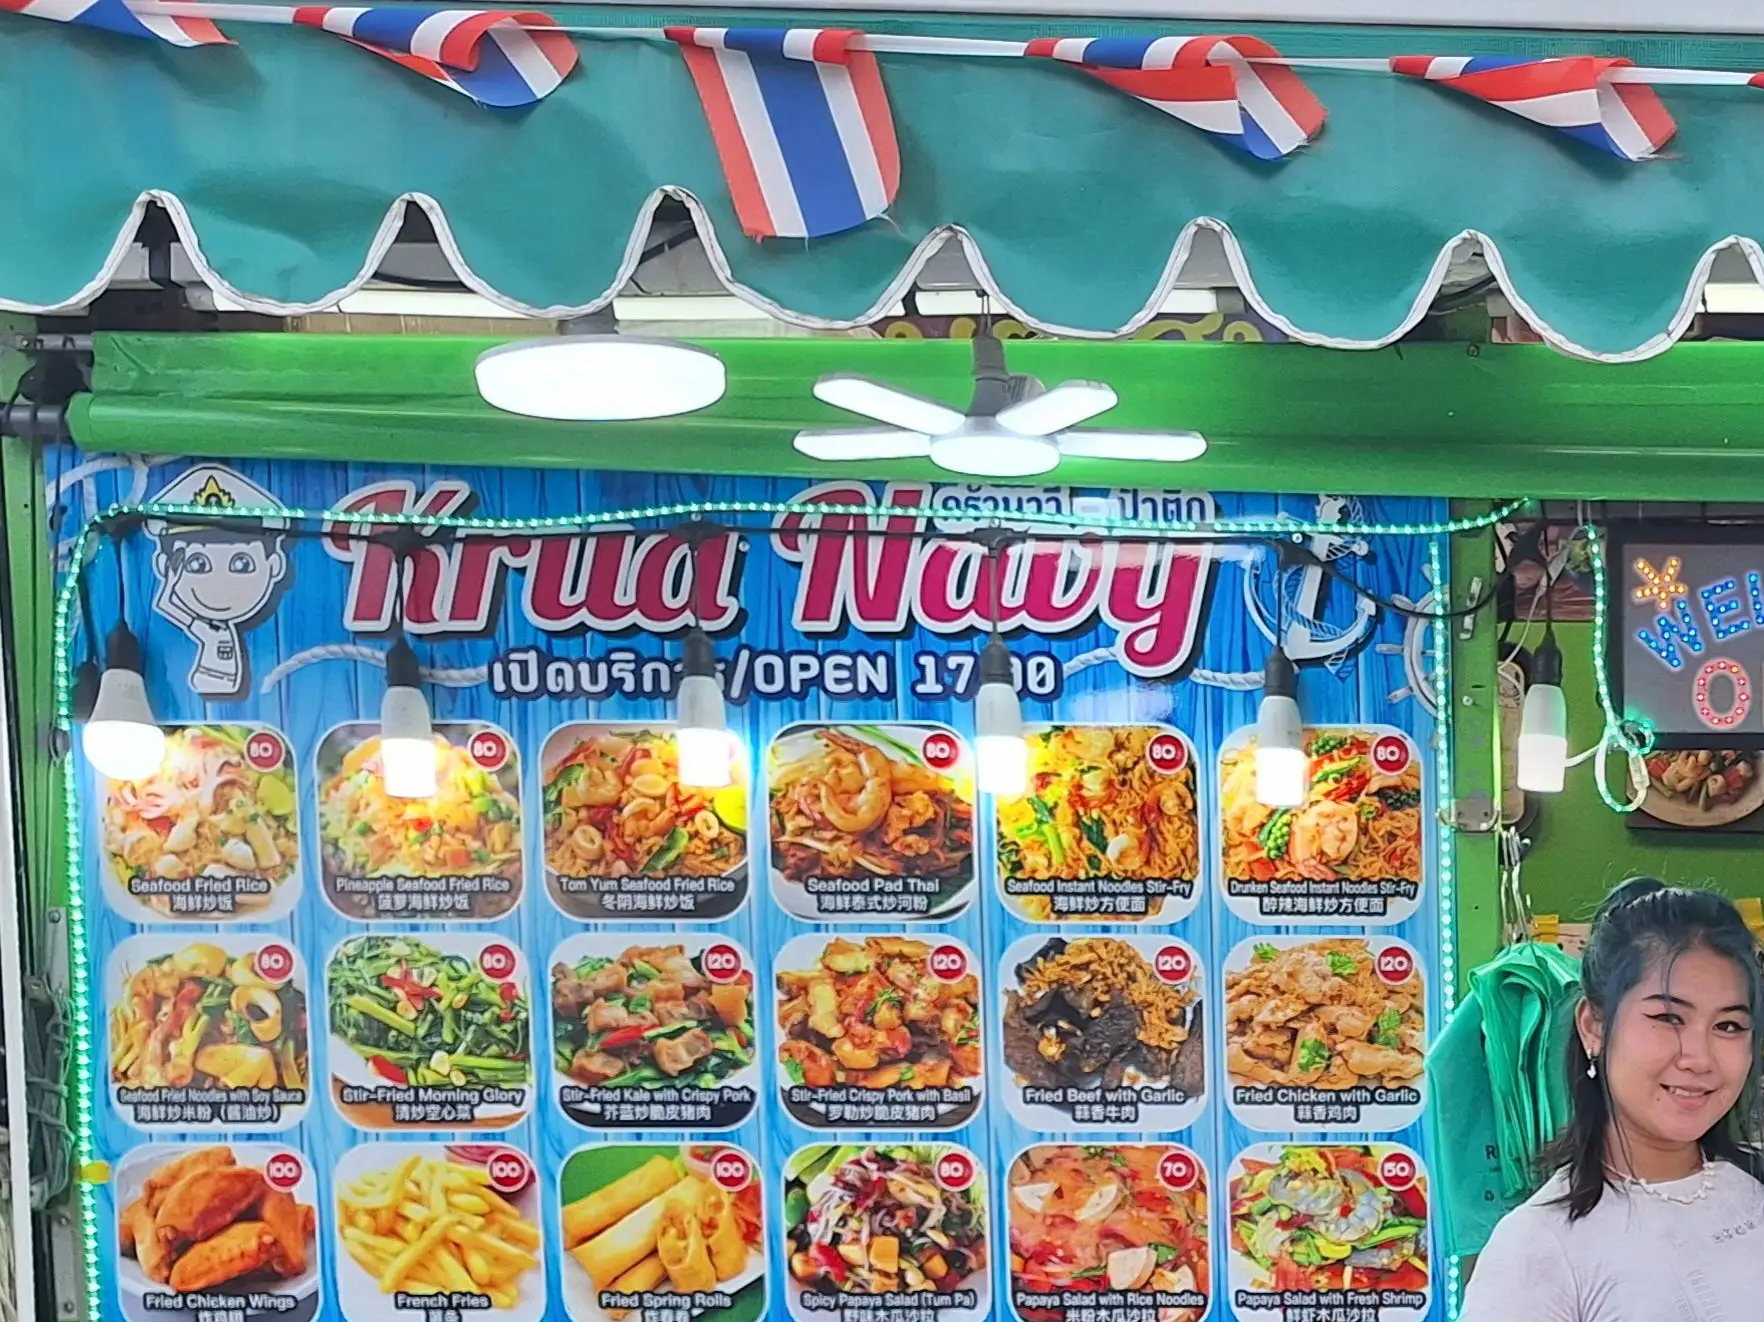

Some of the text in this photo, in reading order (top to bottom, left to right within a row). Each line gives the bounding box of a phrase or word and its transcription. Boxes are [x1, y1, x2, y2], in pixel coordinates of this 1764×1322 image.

[323, 482, 1218, 679] Krua Navy
[915, 654, 1057, 694] 170
[132, 879, 267, 892] Seafood Fried Rice
[560, 879, 735, 891] Tom Yum Seafood Fried Rice
[808, 879, 939, 892] Seafood Pad Thai
[172, 894, 232, 910] 海鲜炒饭
[1025, 1089, 1184, 1103] Fried Beef with Garlic
[1237, 1089, 1417, 1103] Fried Chicken with Garlic
[1073, 1105, 1135, 1120] 蒜香牛肉
[1296, 1105, 1357, 1120] 蒜香鸡肉
[146, 1295, 294, 1311] Fried Chicken Wings
[397, 1294, 488, 1308] French Fries
[602, 1293, 731, 1309] Fried Spring Rolls
